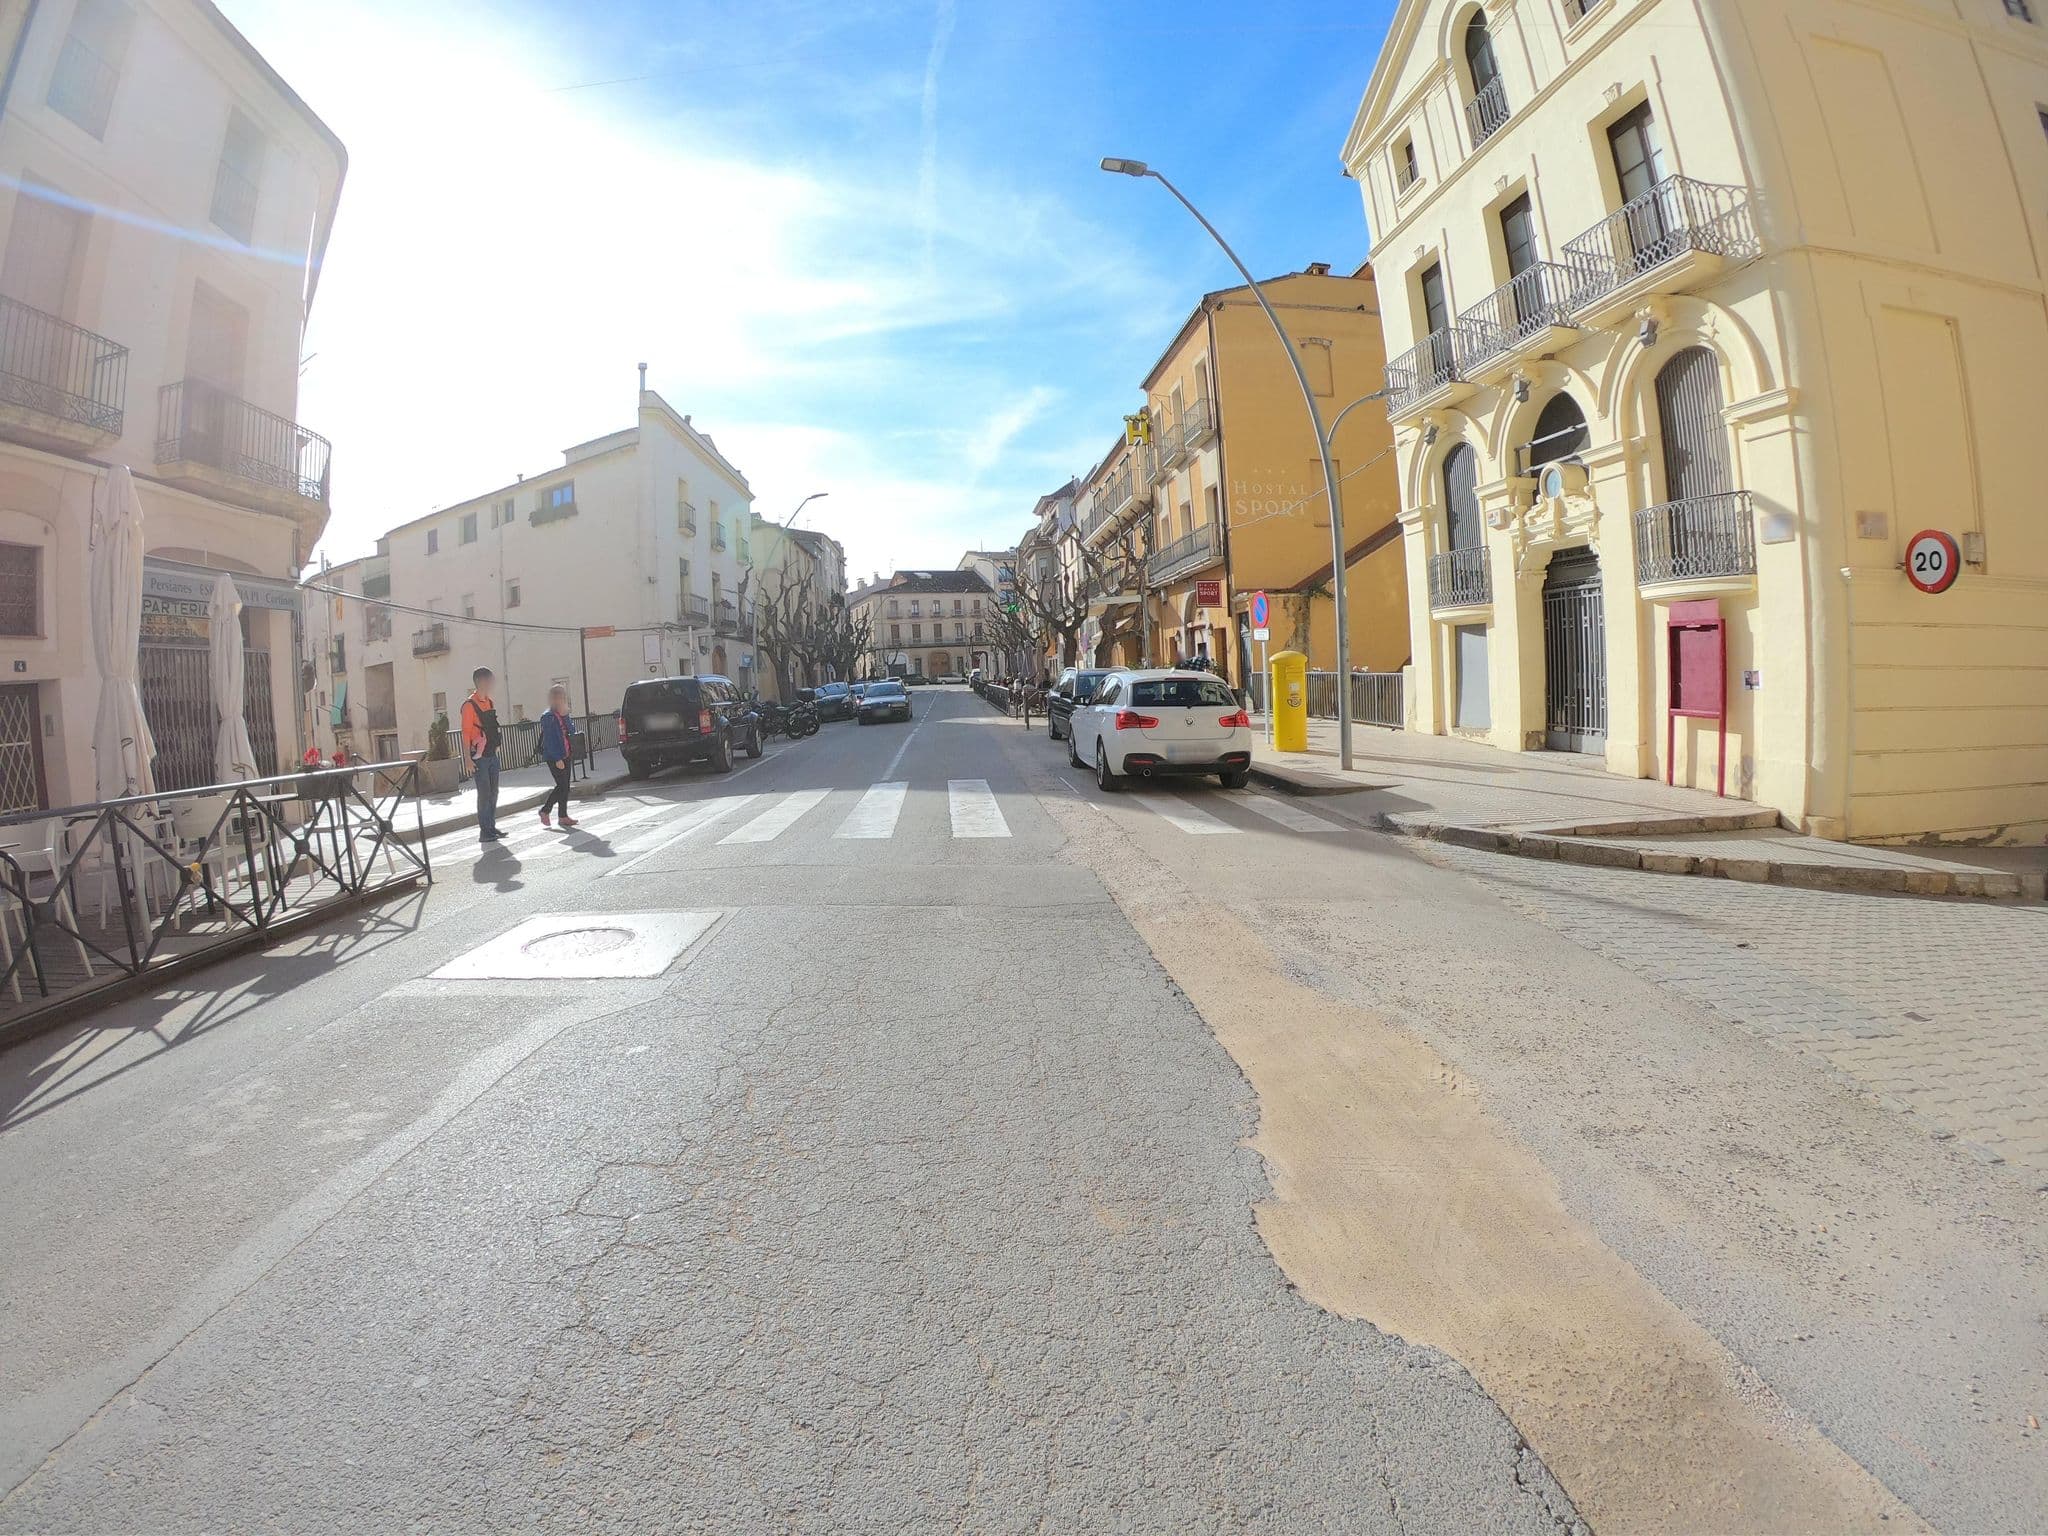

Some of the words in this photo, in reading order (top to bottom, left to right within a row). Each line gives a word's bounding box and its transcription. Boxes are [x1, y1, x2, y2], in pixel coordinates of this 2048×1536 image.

[1235, 499, 1309, 517] SPORT
[1915, 550, 1942, 572] 20
[151, 577, 193, 595] Persianes
